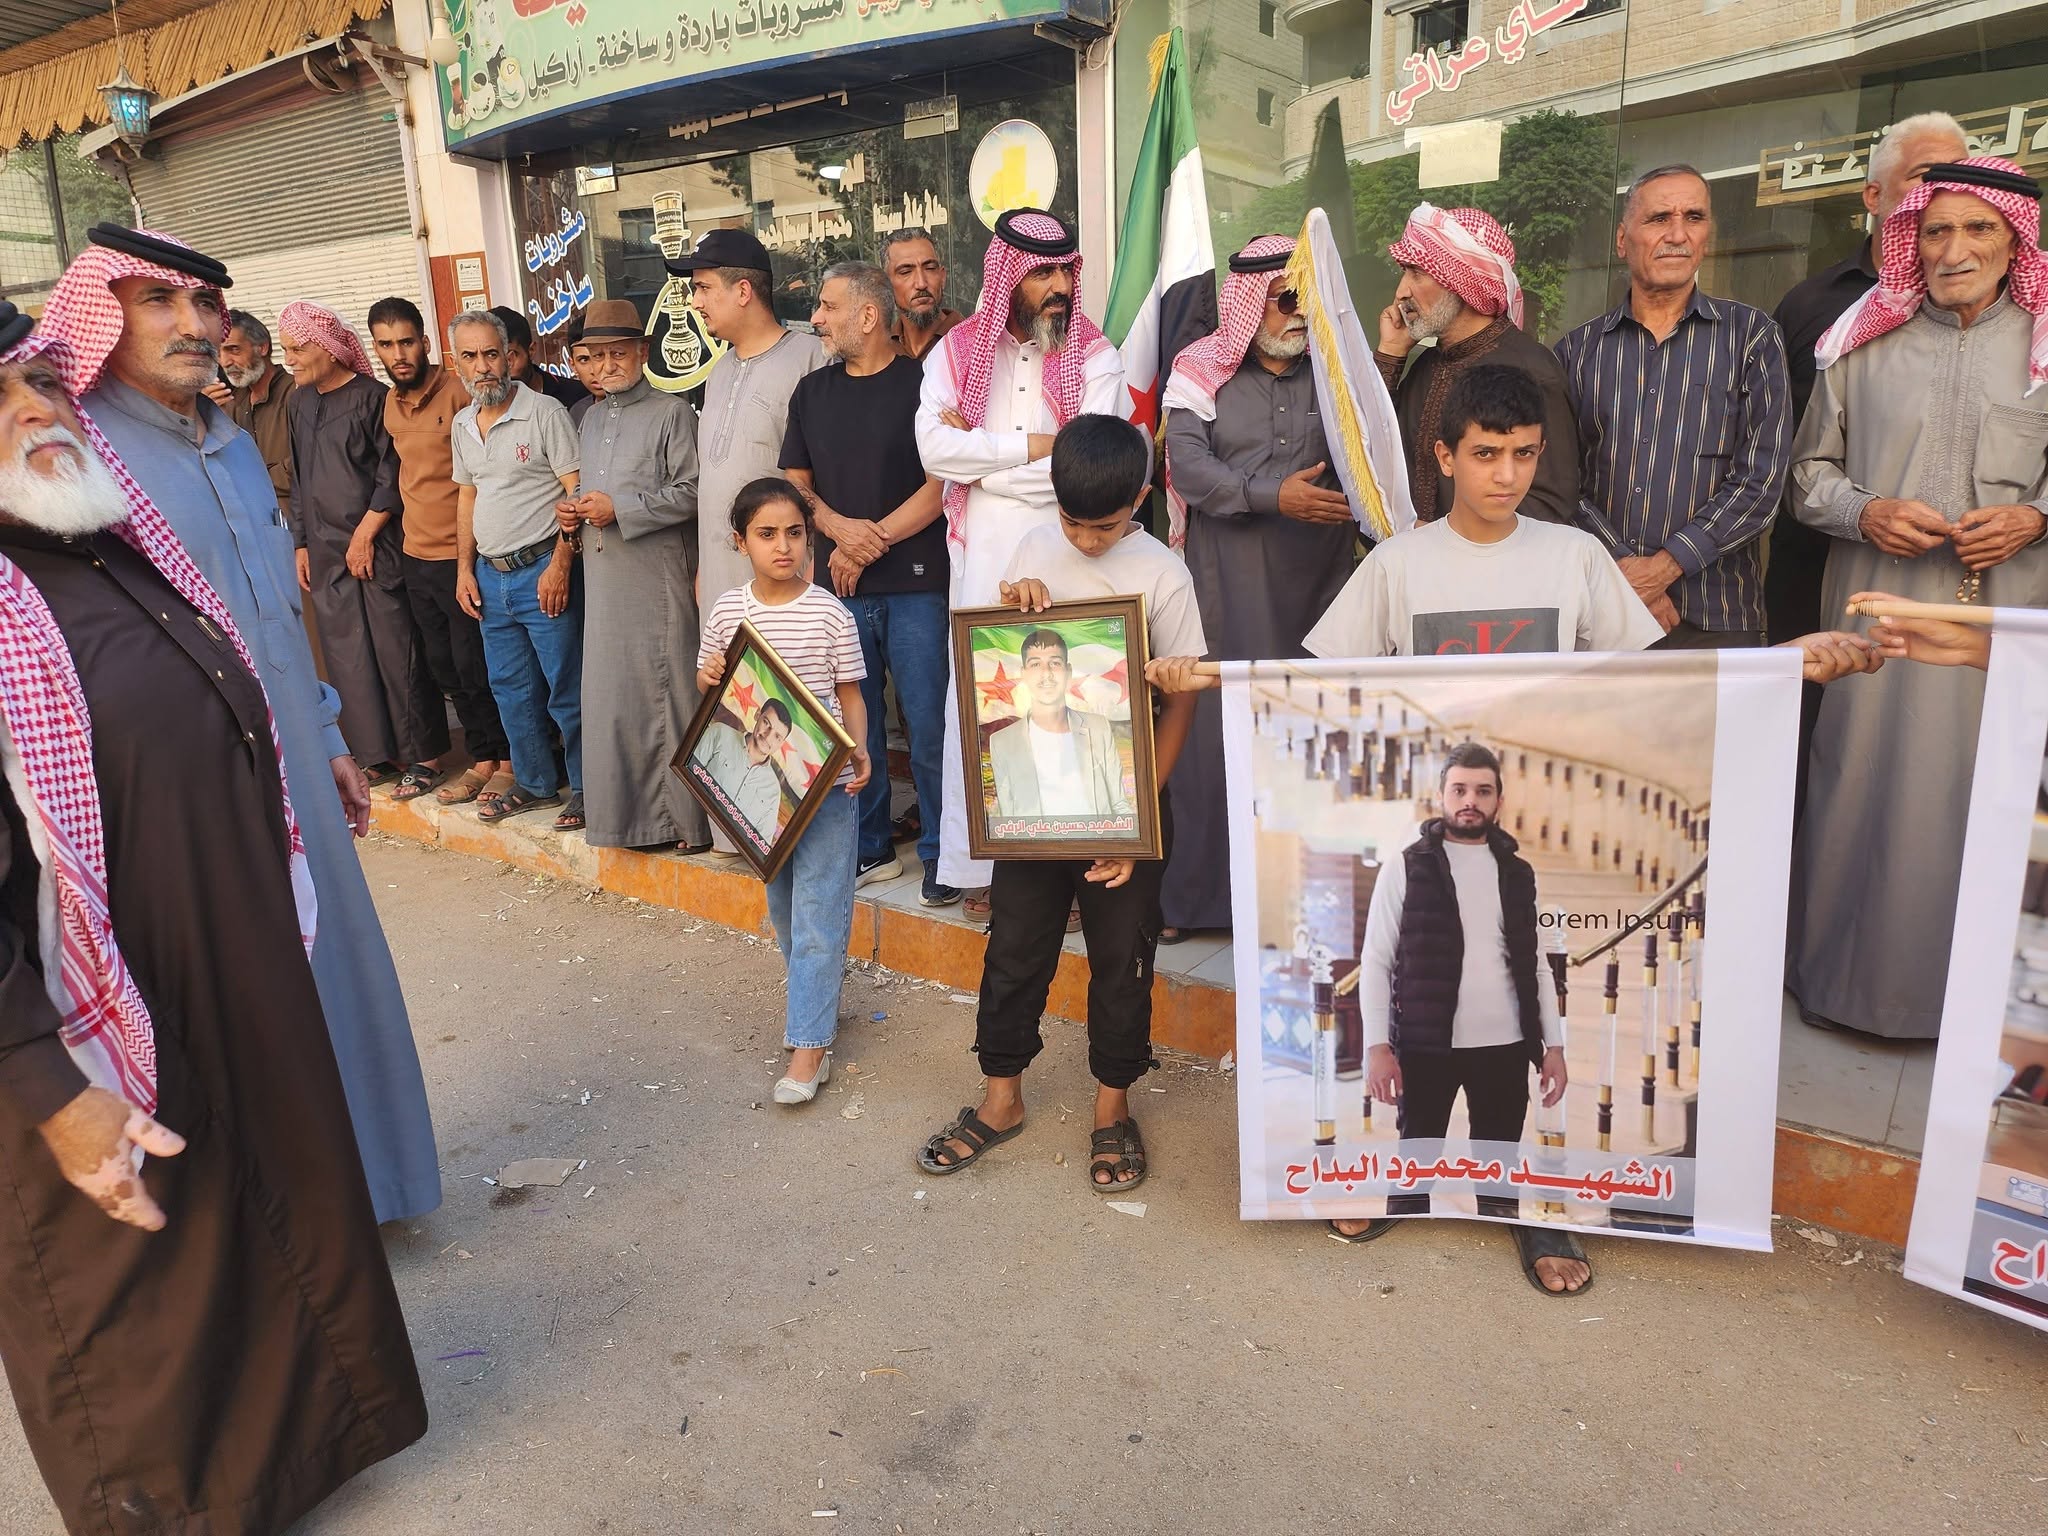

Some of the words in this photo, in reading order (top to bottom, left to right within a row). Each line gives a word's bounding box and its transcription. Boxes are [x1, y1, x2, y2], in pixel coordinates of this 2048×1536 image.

[596, 27, 658, 69] ساخنة
[663, 30, 675, 63] و
[677, 7, 730, 53] باردة
[528, 37, 584, 99] أراكيل
[1386, 36, 1490, 125] عراقي
[525, 207, 585, 273] مشروبات
[528, 270, 594, 337] ساخنة
[1026, 819, 1051, 837] علي
[1052, 820, 1087, 835] حسين
[1088, 816, 1134, 834] الشهيد
[1538, 910, 1609, 930] orem
[1616, 908, 1700, 933] Ipsum
[1285, 1151, 1379, 1195] البداح
[1385, 1155, 1502, 1188] محمود
[1510, 1157, 1674, 1201] الشهيد
